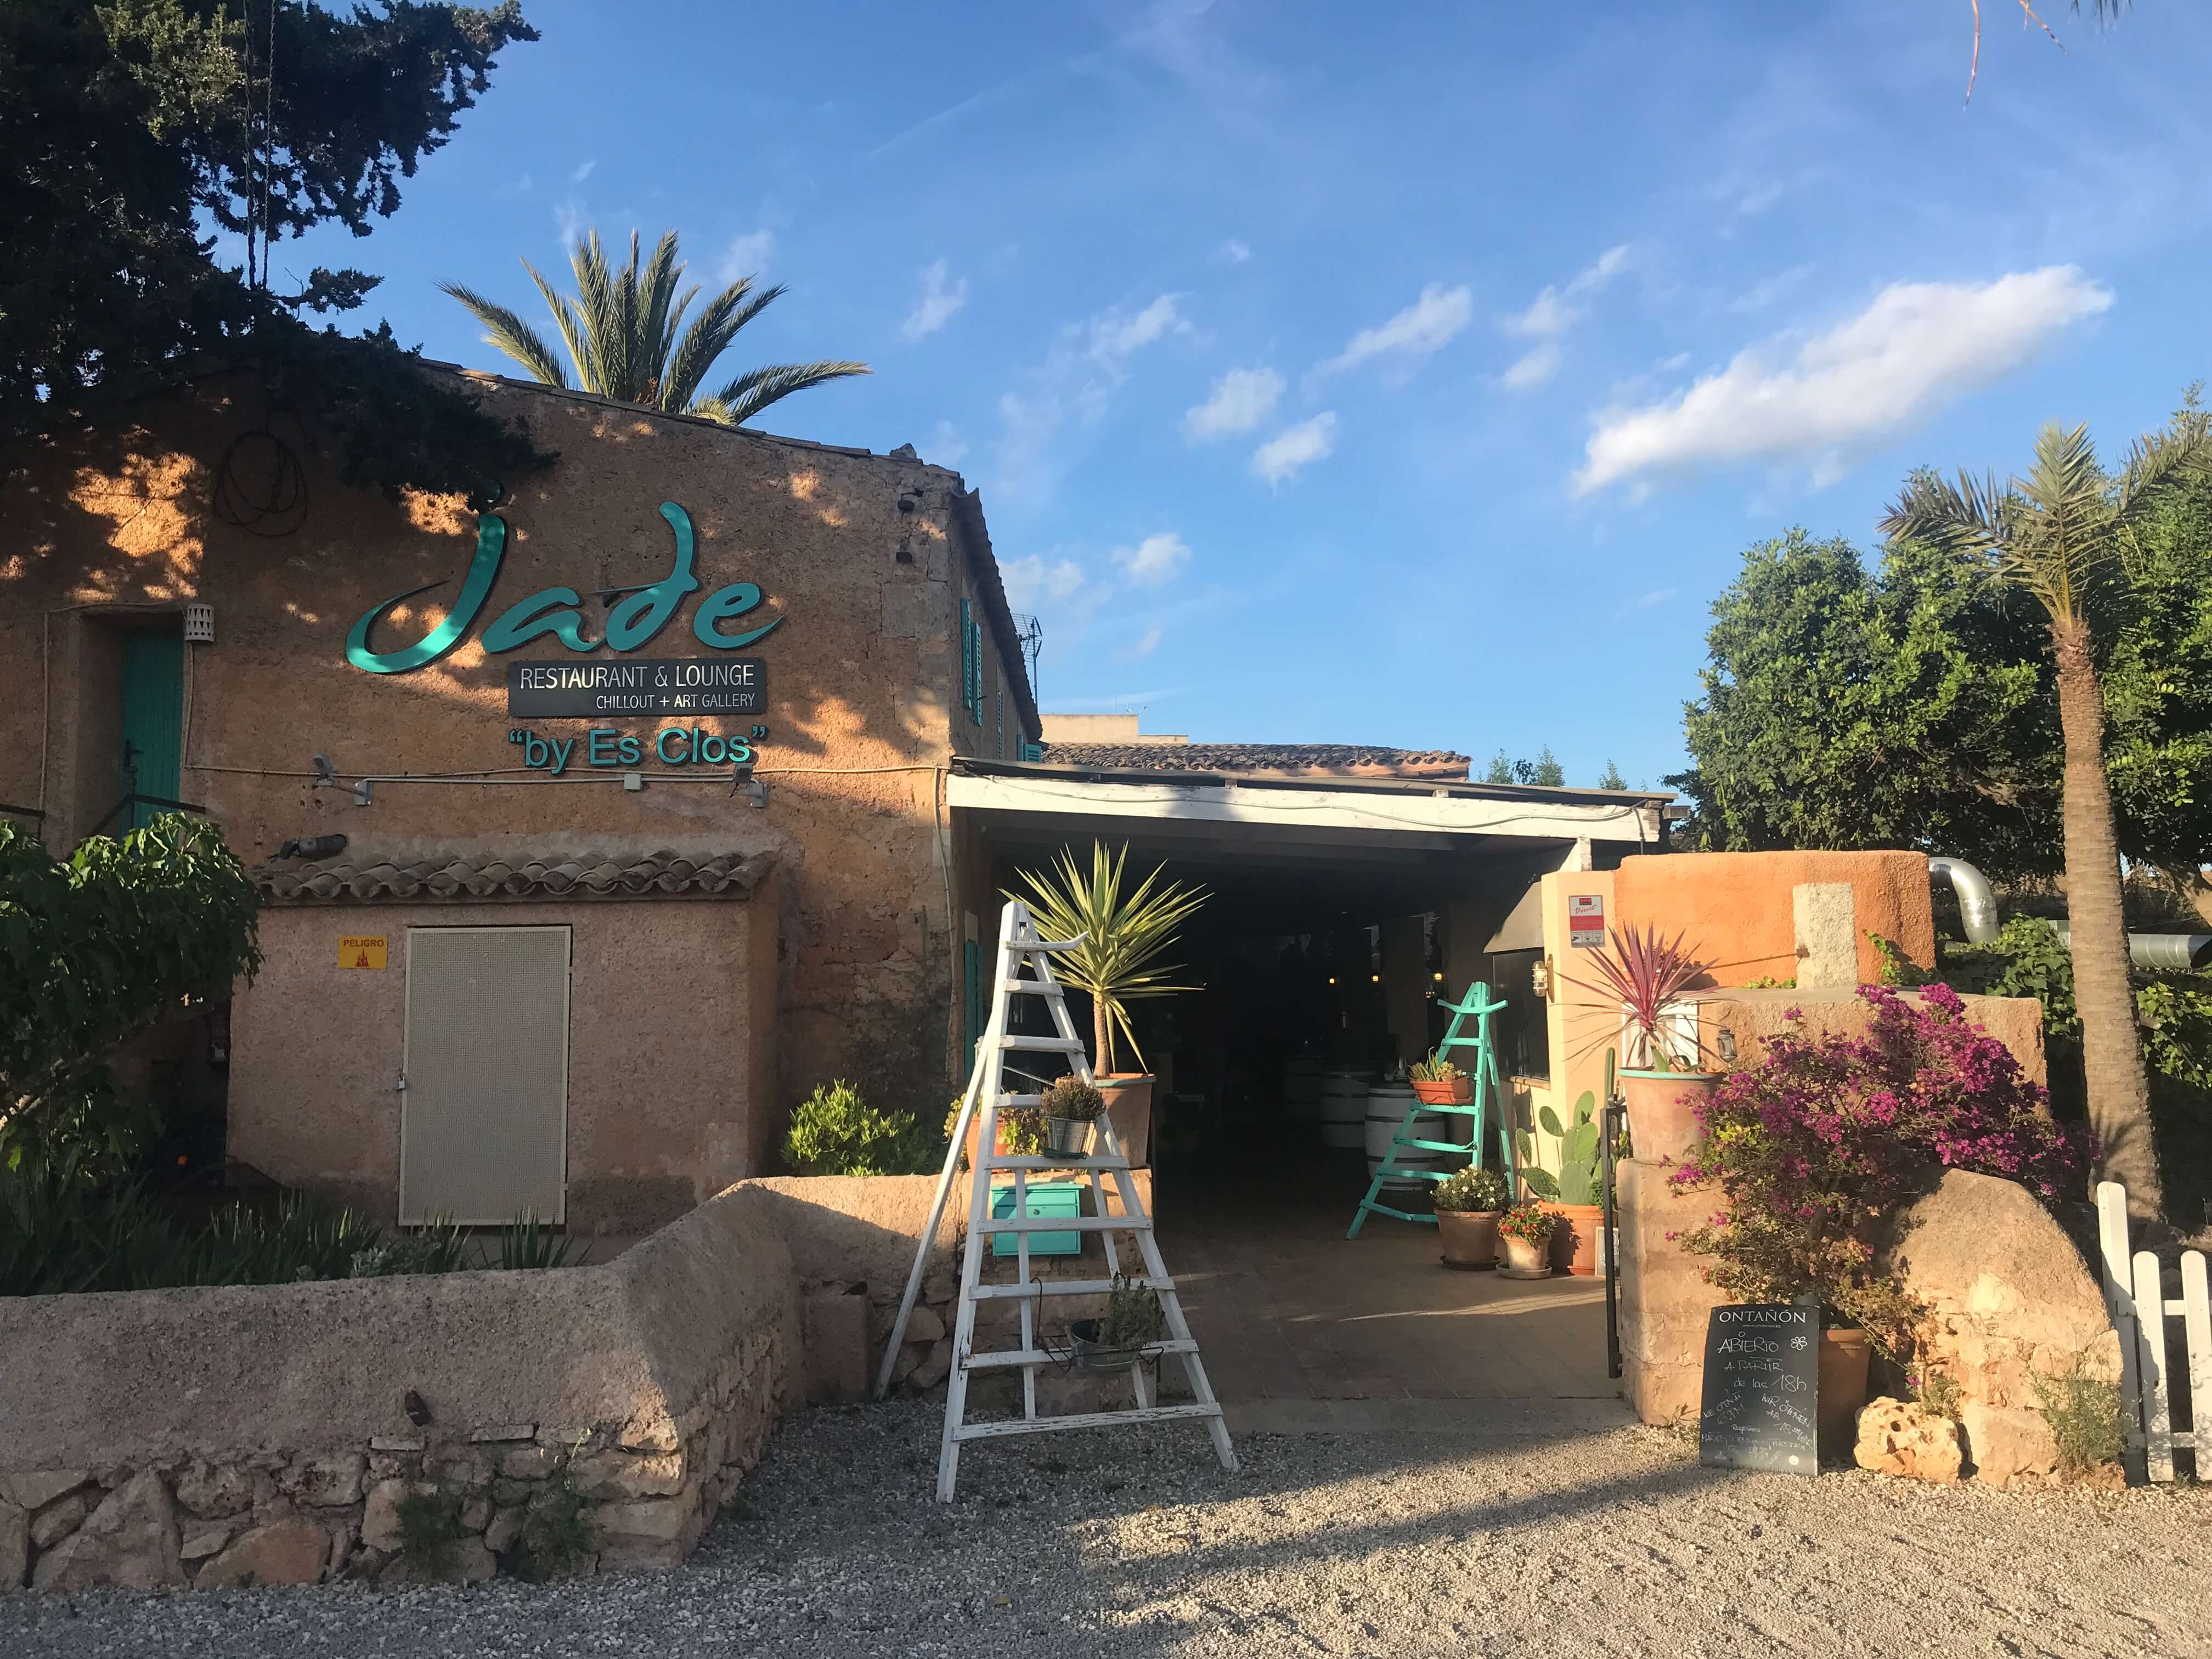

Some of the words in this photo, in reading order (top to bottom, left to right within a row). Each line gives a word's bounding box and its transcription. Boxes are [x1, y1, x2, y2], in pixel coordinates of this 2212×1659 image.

[346, 501, 786, 674] Jade
[520, 665, 648, 690] RESTAURANT
[654, 665, 669, 687] &
[675, 663, 755, 687] LOUNGE
[596, 694, 653, 710] CHILLOUT
[673, 693, 698, 709] ART
[701, 692, 755, 708] GALLERY
[589, 728, 641, 767] Es
[1719, 1309, 1807, 1323] ONTAÑÓN
[1724, 1362, 1736, 1372] A
[1734, 1376, 1747, 1387] de
[1752, 1378, 1768, 1389] las
